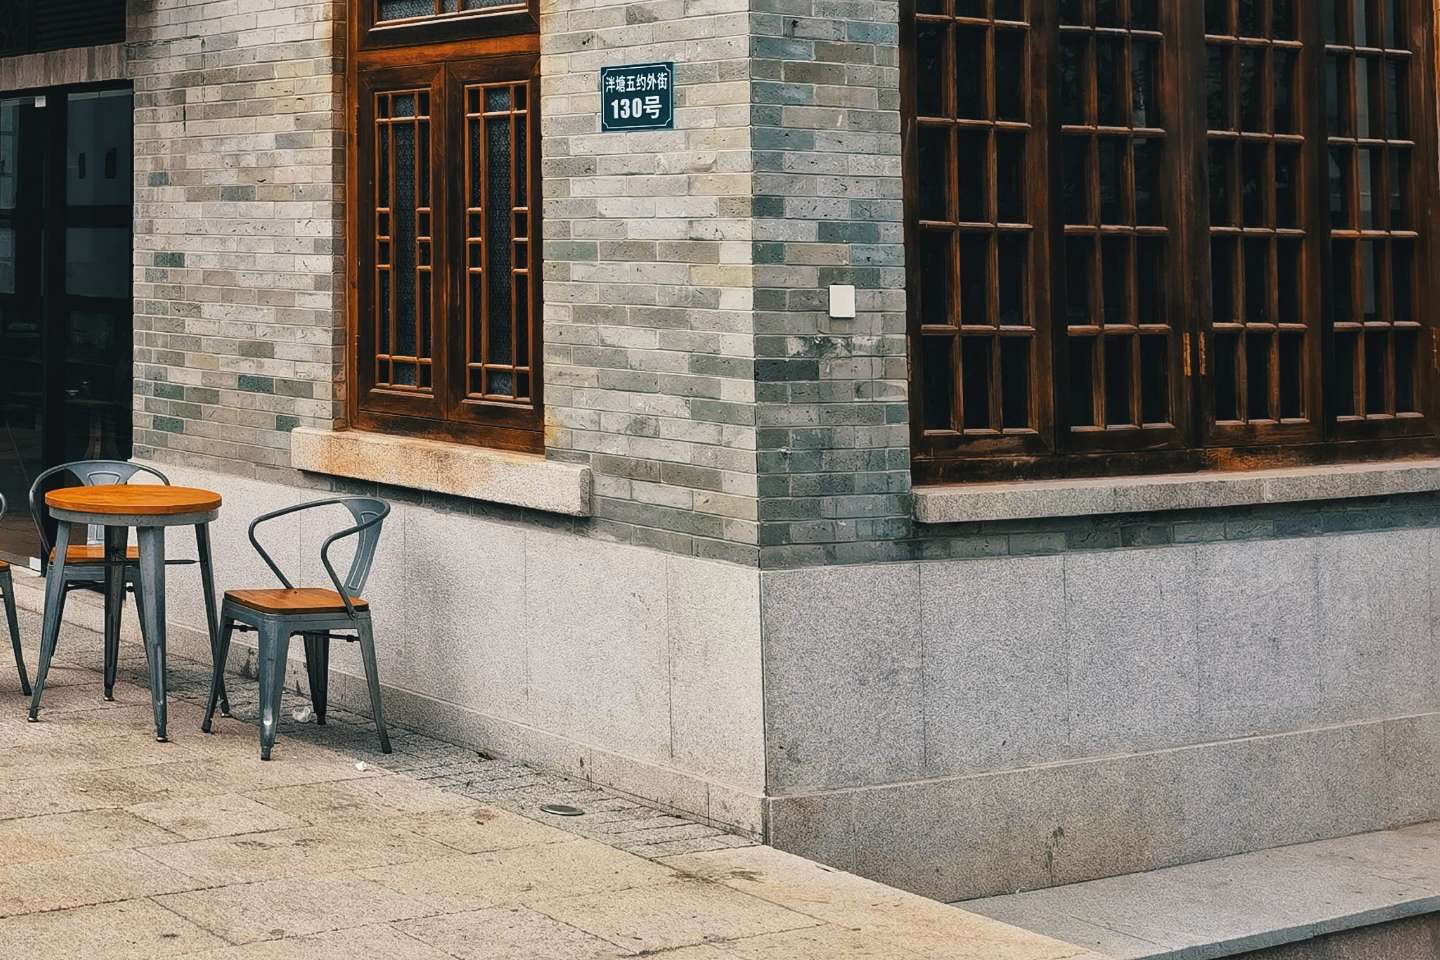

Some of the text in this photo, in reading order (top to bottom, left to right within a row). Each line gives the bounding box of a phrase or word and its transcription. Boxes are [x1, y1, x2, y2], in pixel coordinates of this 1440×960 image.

[605, 72, 668, 93] 泮塘五约外街
[611, 95, 662, 119] 130号
